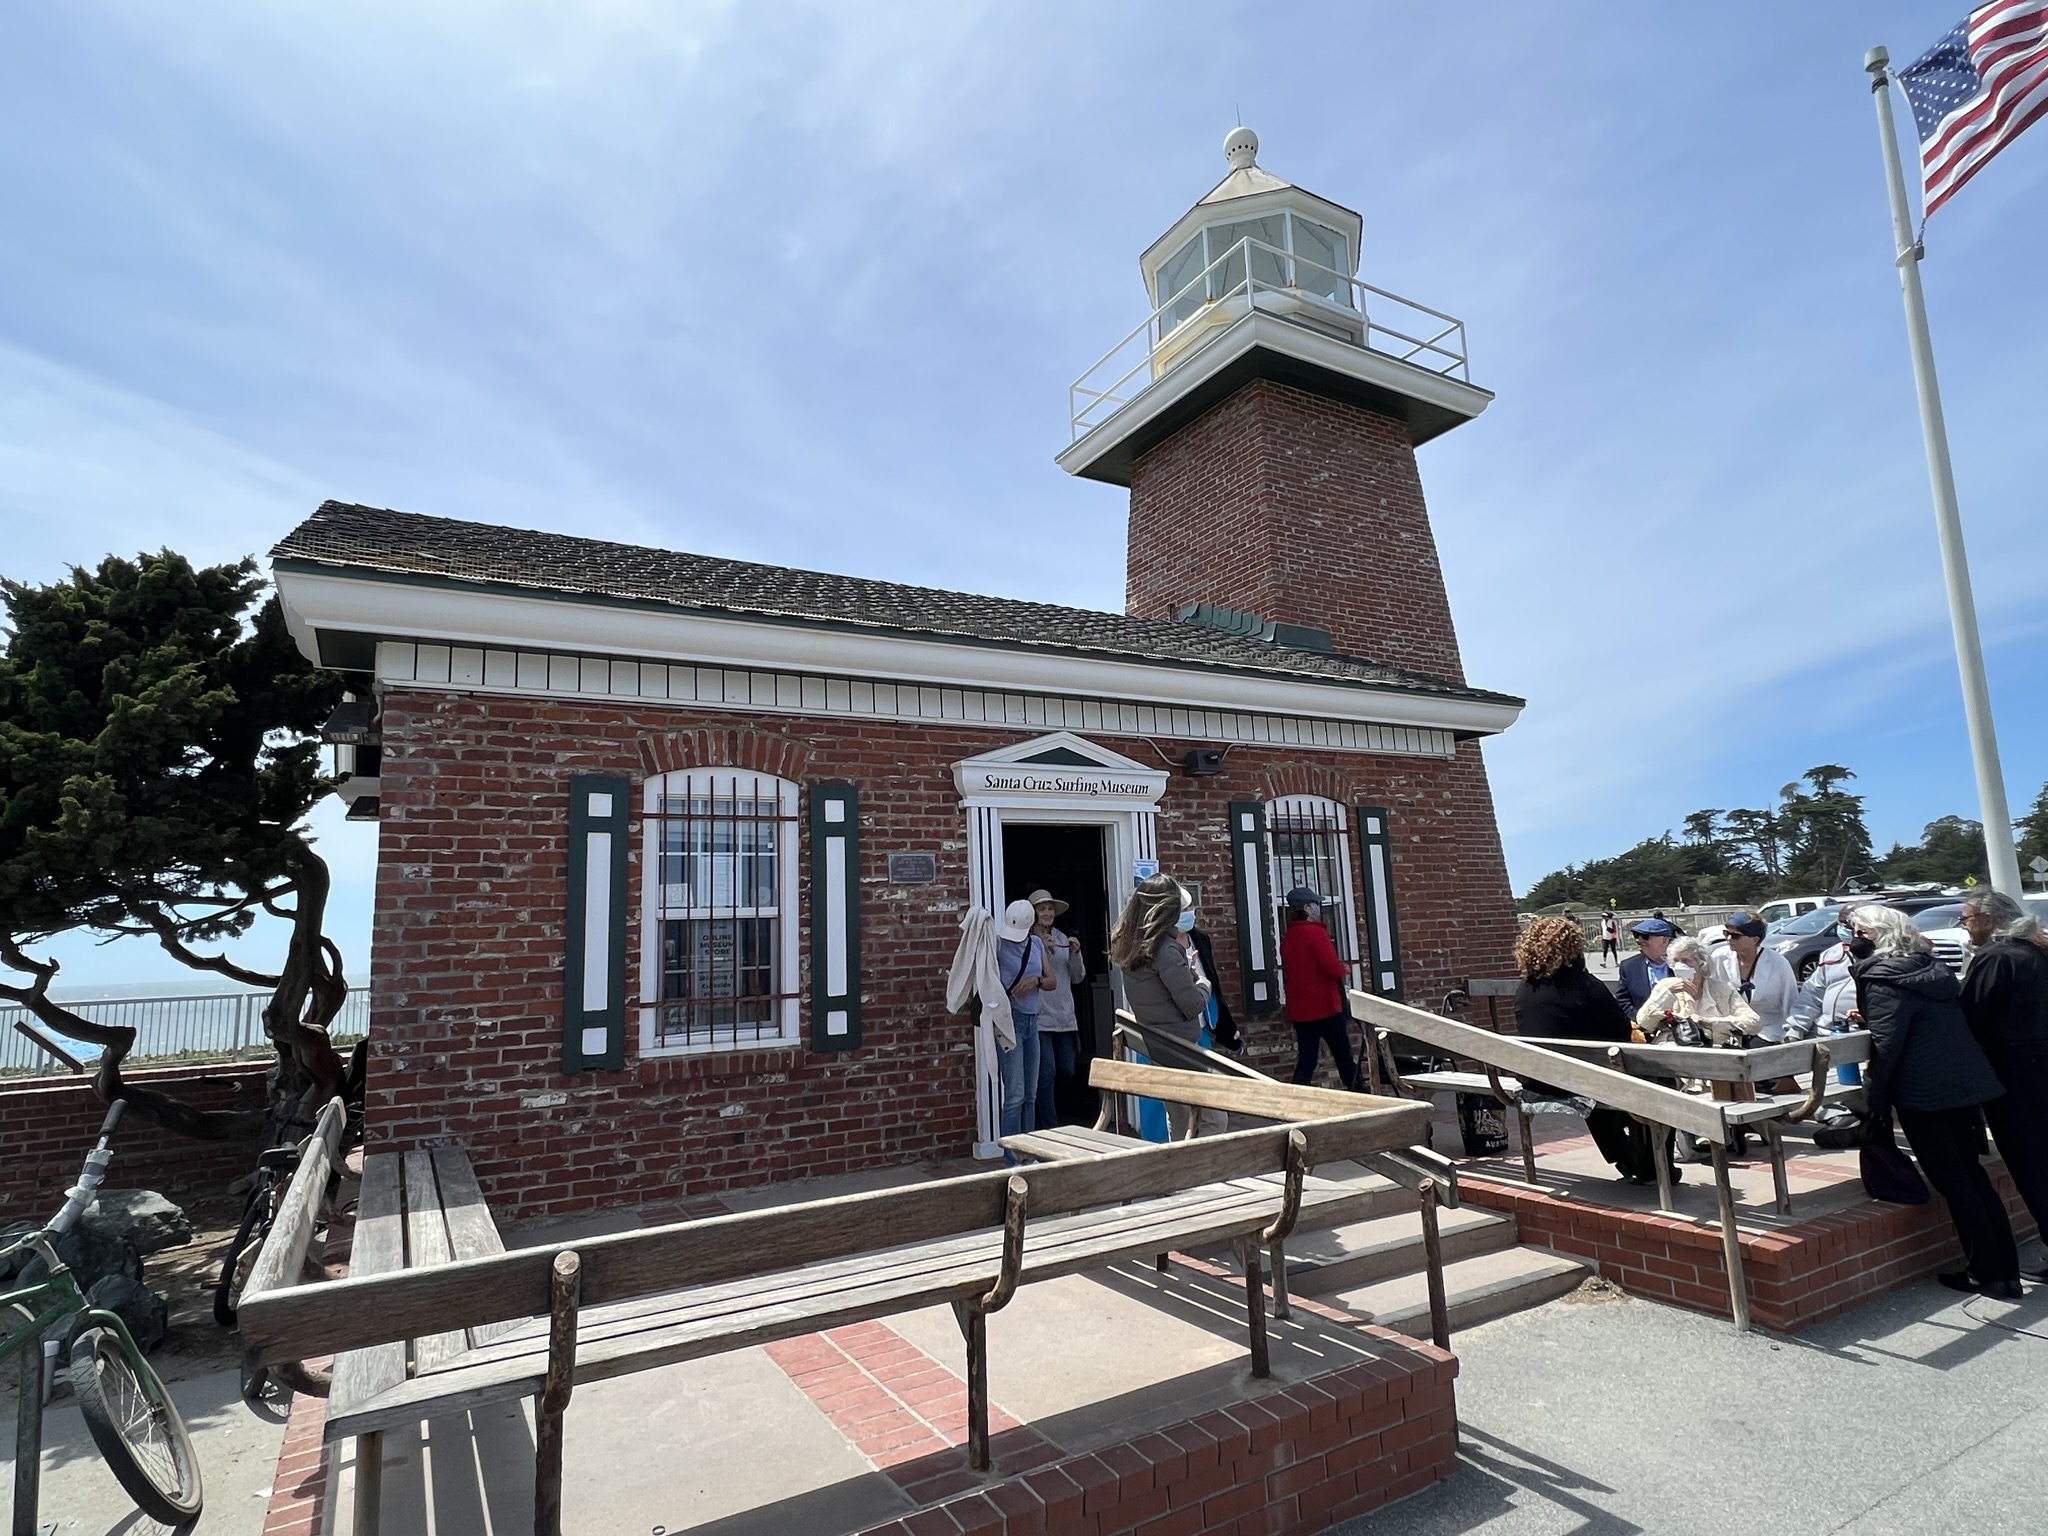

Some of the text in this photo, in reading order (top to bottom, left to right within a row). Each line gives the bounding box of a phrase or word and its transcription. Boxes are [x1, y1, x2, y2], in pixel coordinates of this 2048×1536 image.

[984, 774, 1149, 796] Santa Cruz Surfing Museum
